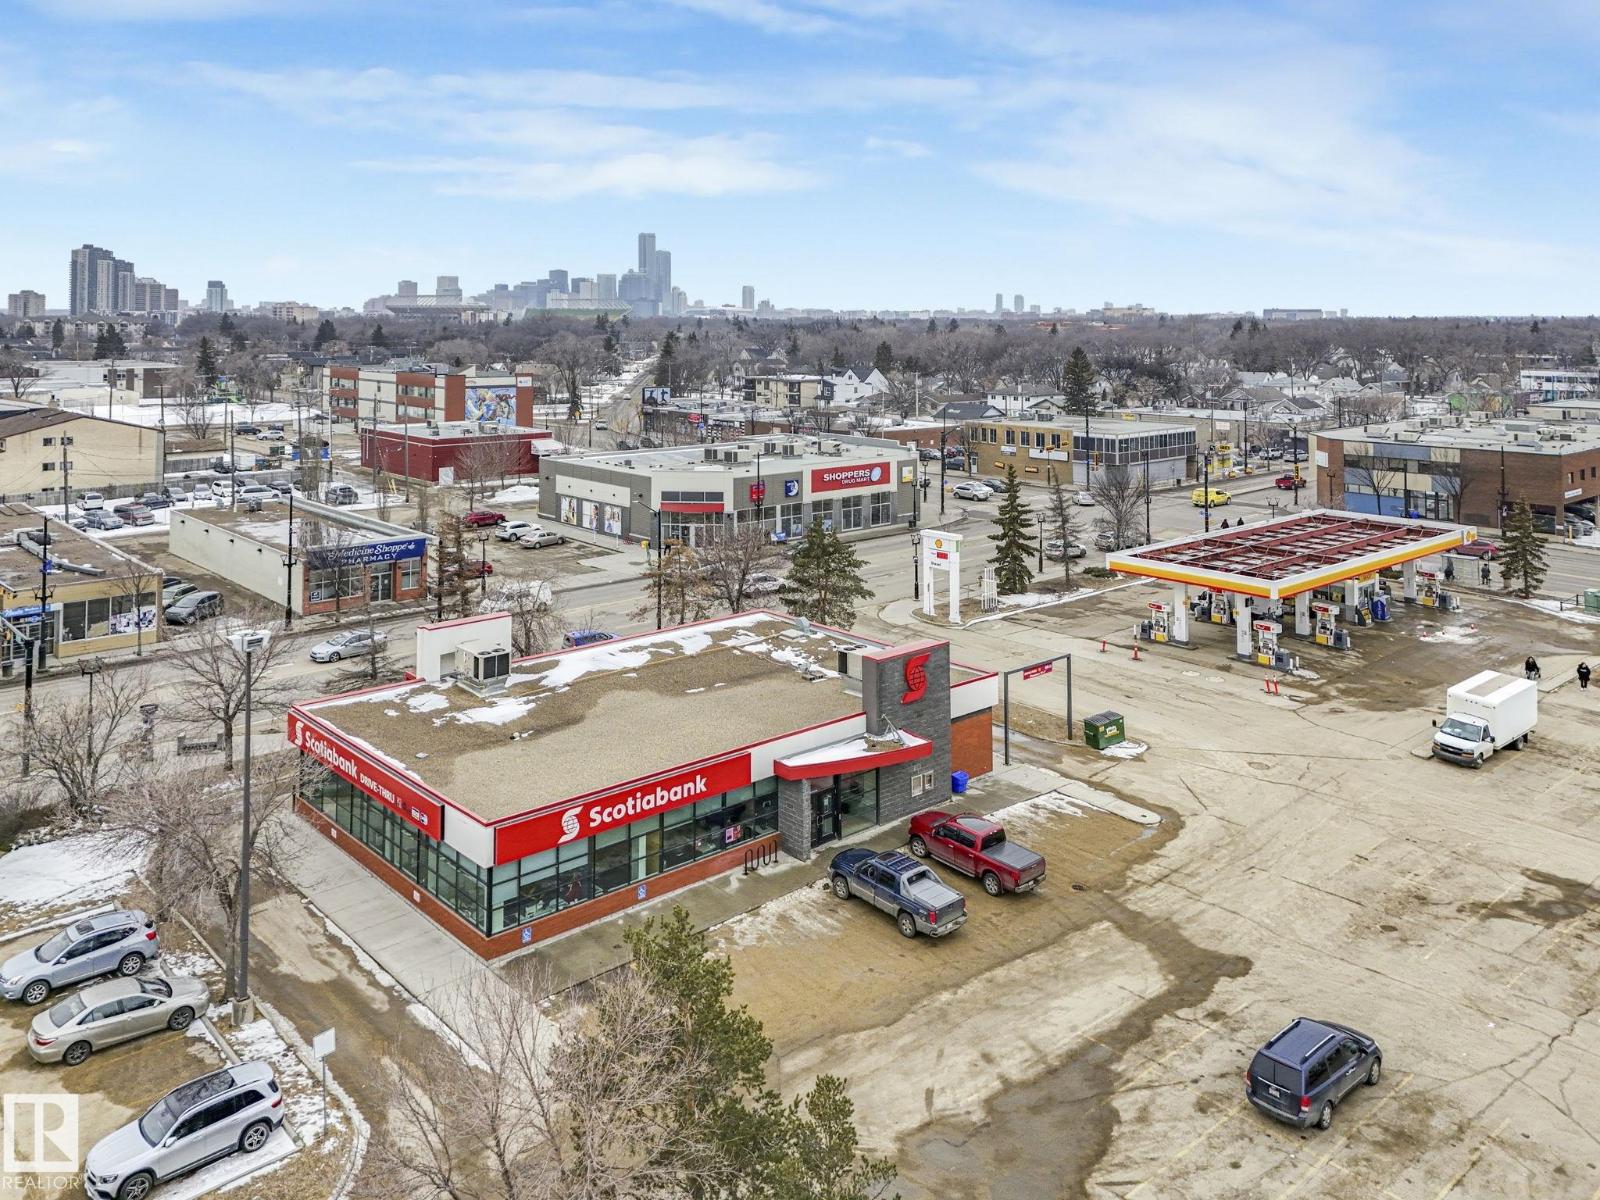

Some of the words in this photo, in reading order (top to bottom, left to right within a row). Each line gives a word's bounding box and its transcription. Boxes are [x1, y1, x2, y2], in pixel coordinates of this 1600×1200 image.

[823, 469, 870, 481] SHOPPERS
[374, 543, 407, 555] Shoppe
[305, 731, 358, 780] Scotiabank
[359, 773, 395, 804] DRIVE-THRU
[589, 775, 708, 828] Scotiabank
